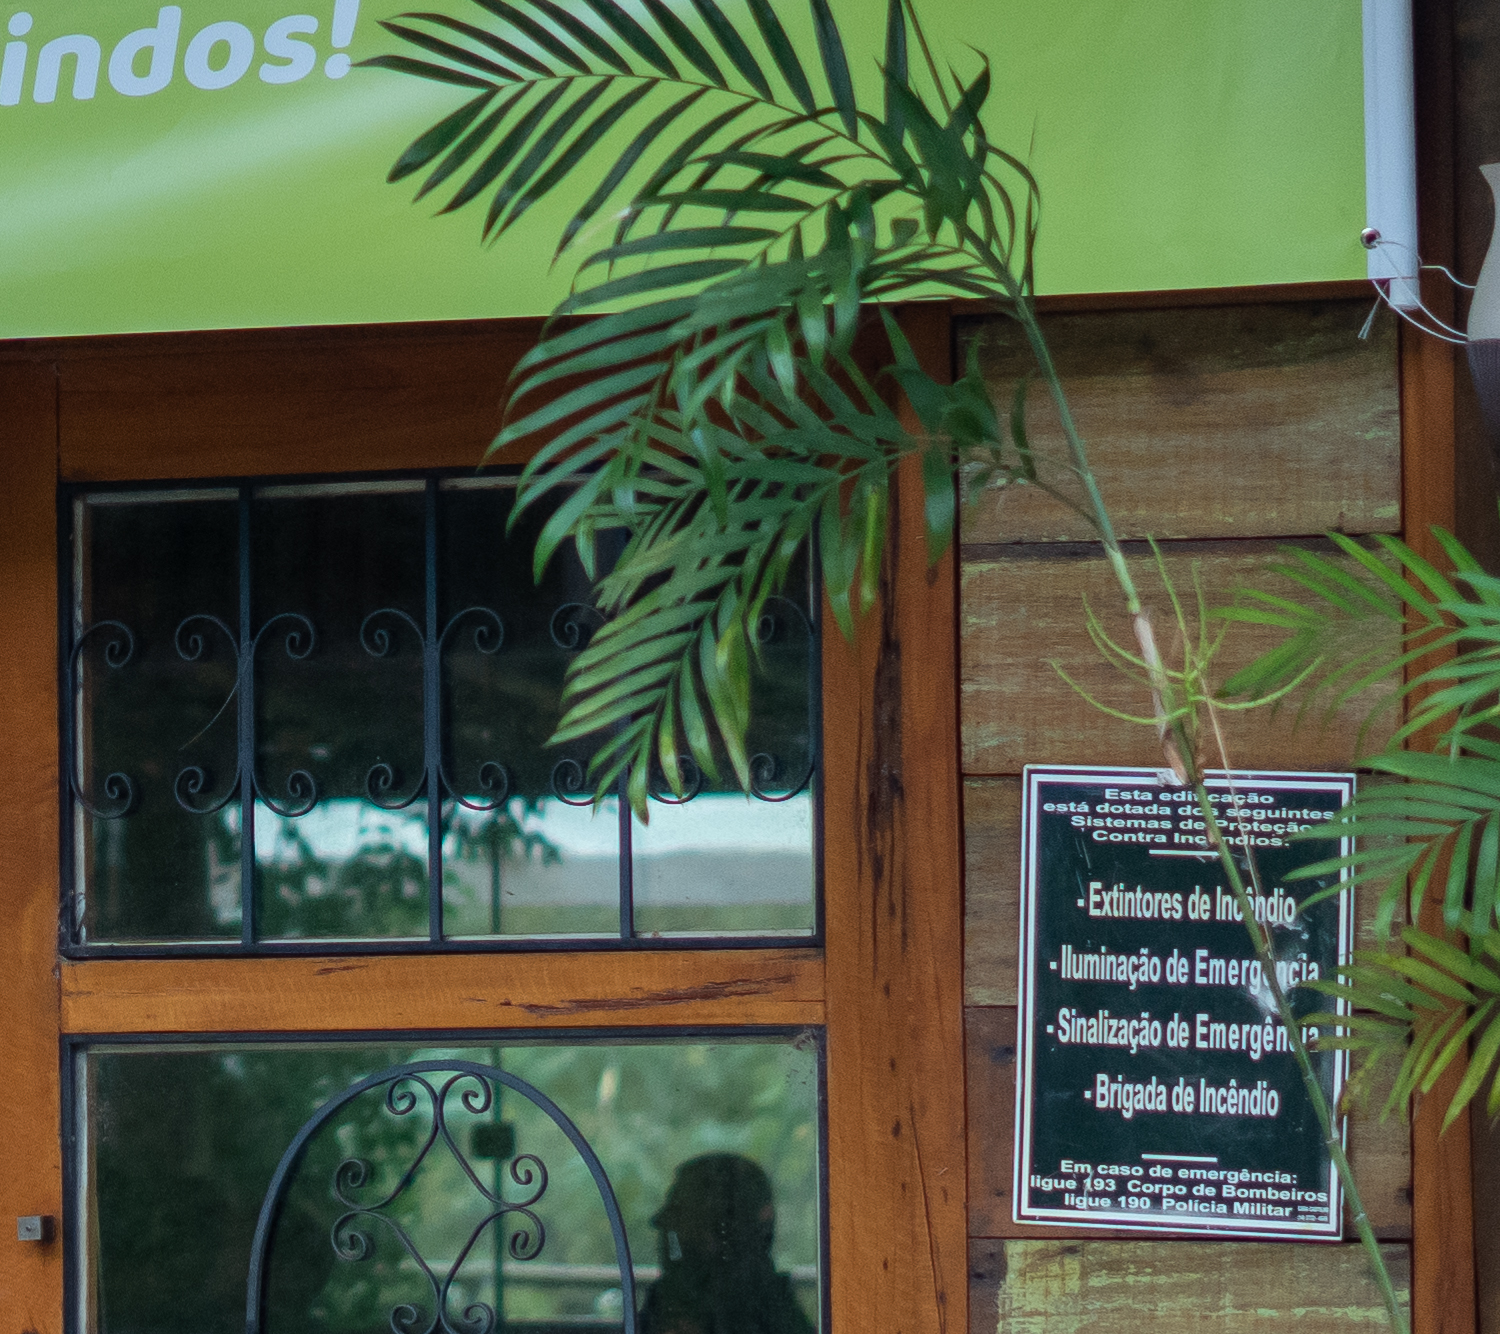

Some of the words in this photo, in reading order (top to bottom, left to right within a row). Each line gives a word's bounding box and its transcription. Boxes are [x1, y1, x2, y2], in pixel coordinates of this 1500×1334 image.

[1104, 788, 1153, 801] Esta
[1159, 790, 1275, 806] edicação
[1043, 801, 1089, 813] está
[1096, 802, 1171, 816] dotada
[1226, 807, 1335, 820] seguintes
[1070, 815, 1173, 829] Sistemas
[1179, 818, 1206, 830] de
[1092, 830, 1167, 843] Contra
[1088, 881, 1183, 919] Extintores
[1187, 885, 1211, 921] de
[1061, 944, 1161, 991] Iluminação
[1165, 948, 1189, 984] de
[1195, 949, 1320, 996] Emergncia
[1057, 1007, 1162, 1055] Sinalização
[1166, 1012, 1190, 1048] de
[1195, 1013, 1320, 1061] Emergênia
[1095, 1073, 1168, 1119] Brigada
[1171, 1077, 1195, 1113] de
[1199, 1077, 1280, 1117] Incêndio
[1060, 1160, 1093, 1174] Em
[1097, 1164, 1144, 1177] caso
[1148, 1165, 1172, 1178] de
[1178, 1167, 1298, 1184] emergência:
[1030, 1175, 1077, 1191] ligue
[1082, 1178, 1117, 1192] 193
[1127, 1180, 1188, 1197] Corpo
[1192, 1183, 1216, 1197] de
[1222, 1185, 1328, 1202] Bombeiros
[1064, 1193, 1111, 1209] ligue
[1118, 1196, 1150, 1210] 190
[1162, 1198, 1227, 1214] Polícia
[1233, 1202, 1293, 1217] Militar
